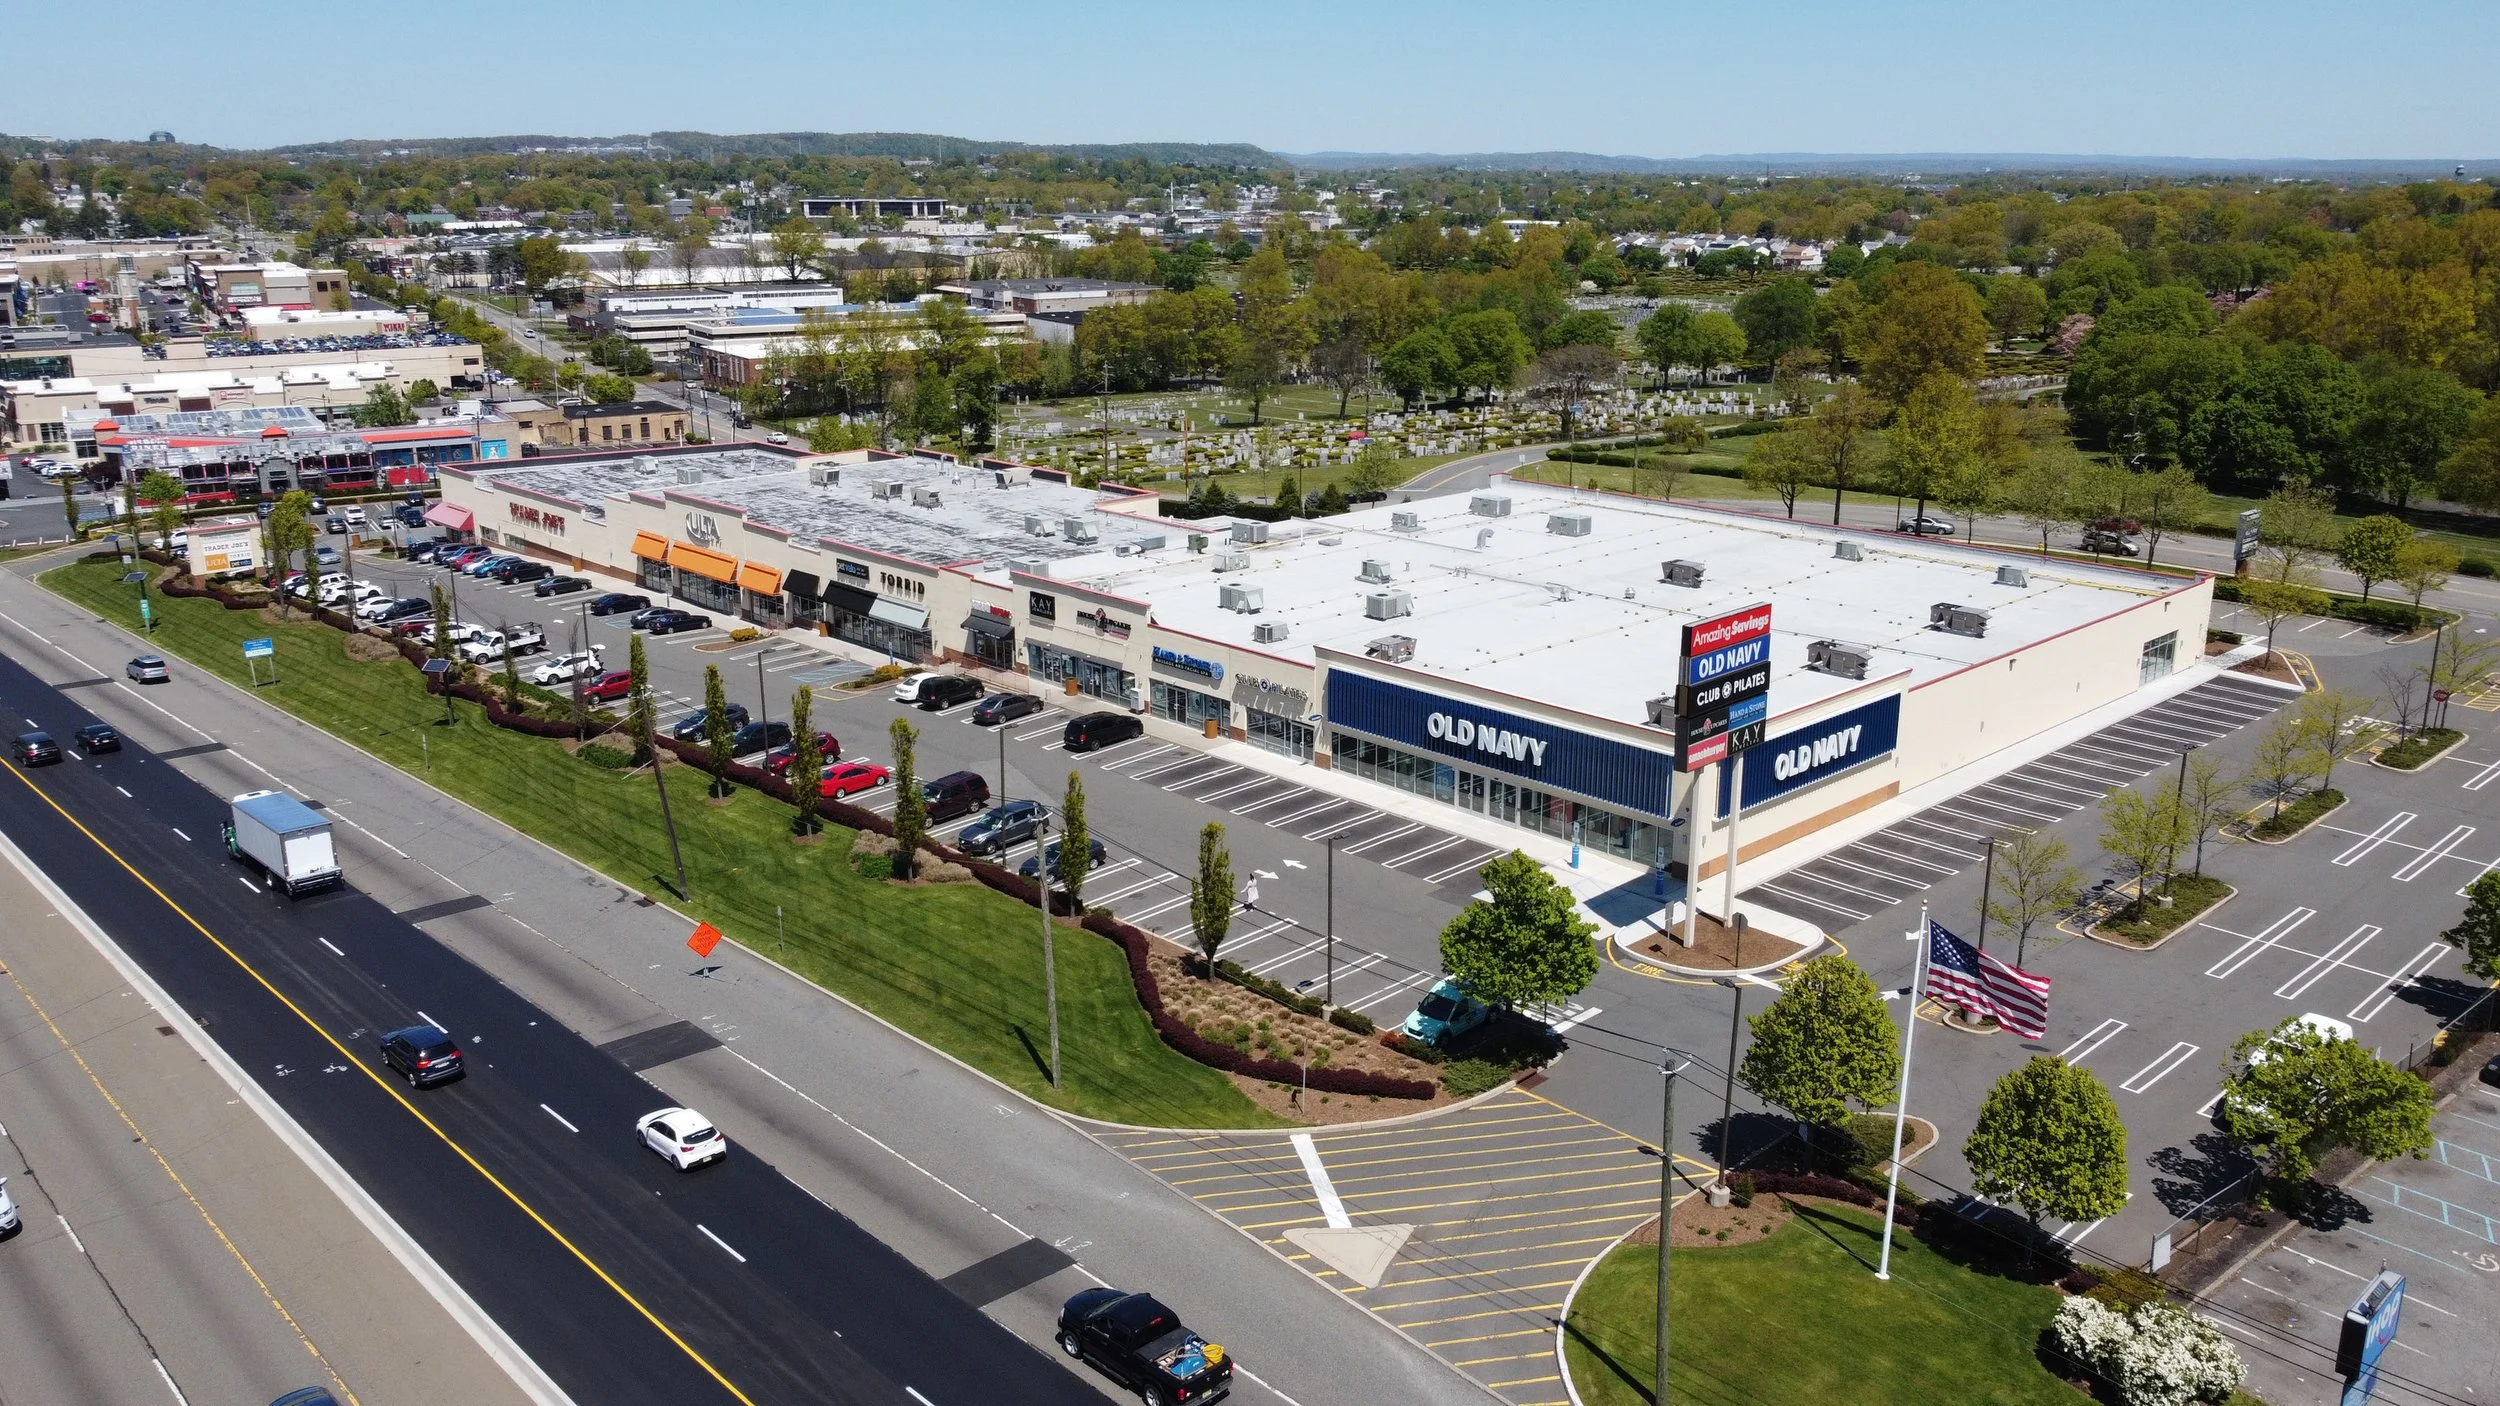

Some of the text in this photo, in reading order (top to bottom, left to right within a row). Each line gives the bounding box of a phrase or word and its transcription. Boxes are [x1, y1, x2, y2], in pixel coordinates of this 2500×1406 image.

[204, 543, 229, 552] TRADER
[880, 571, 925, 595] TORRID
[1031, 596, 1052, 611] KAY
[1693, 614, 1770, 648] Amazing Savings
[1699, 641, 1762, 678] OLD NAVY
[1696, 671, 1766, 706] CLUB PILATES
[1427, 712, 1548, 767] OLD NAVY
[1732, 723, 1761, 748] KAY
[1775, 724, 1862, 781] OLD NAVY
[1633, 963, 1666, 977] FIRE
[2365, 1291, 2401, 1349] IHOP
